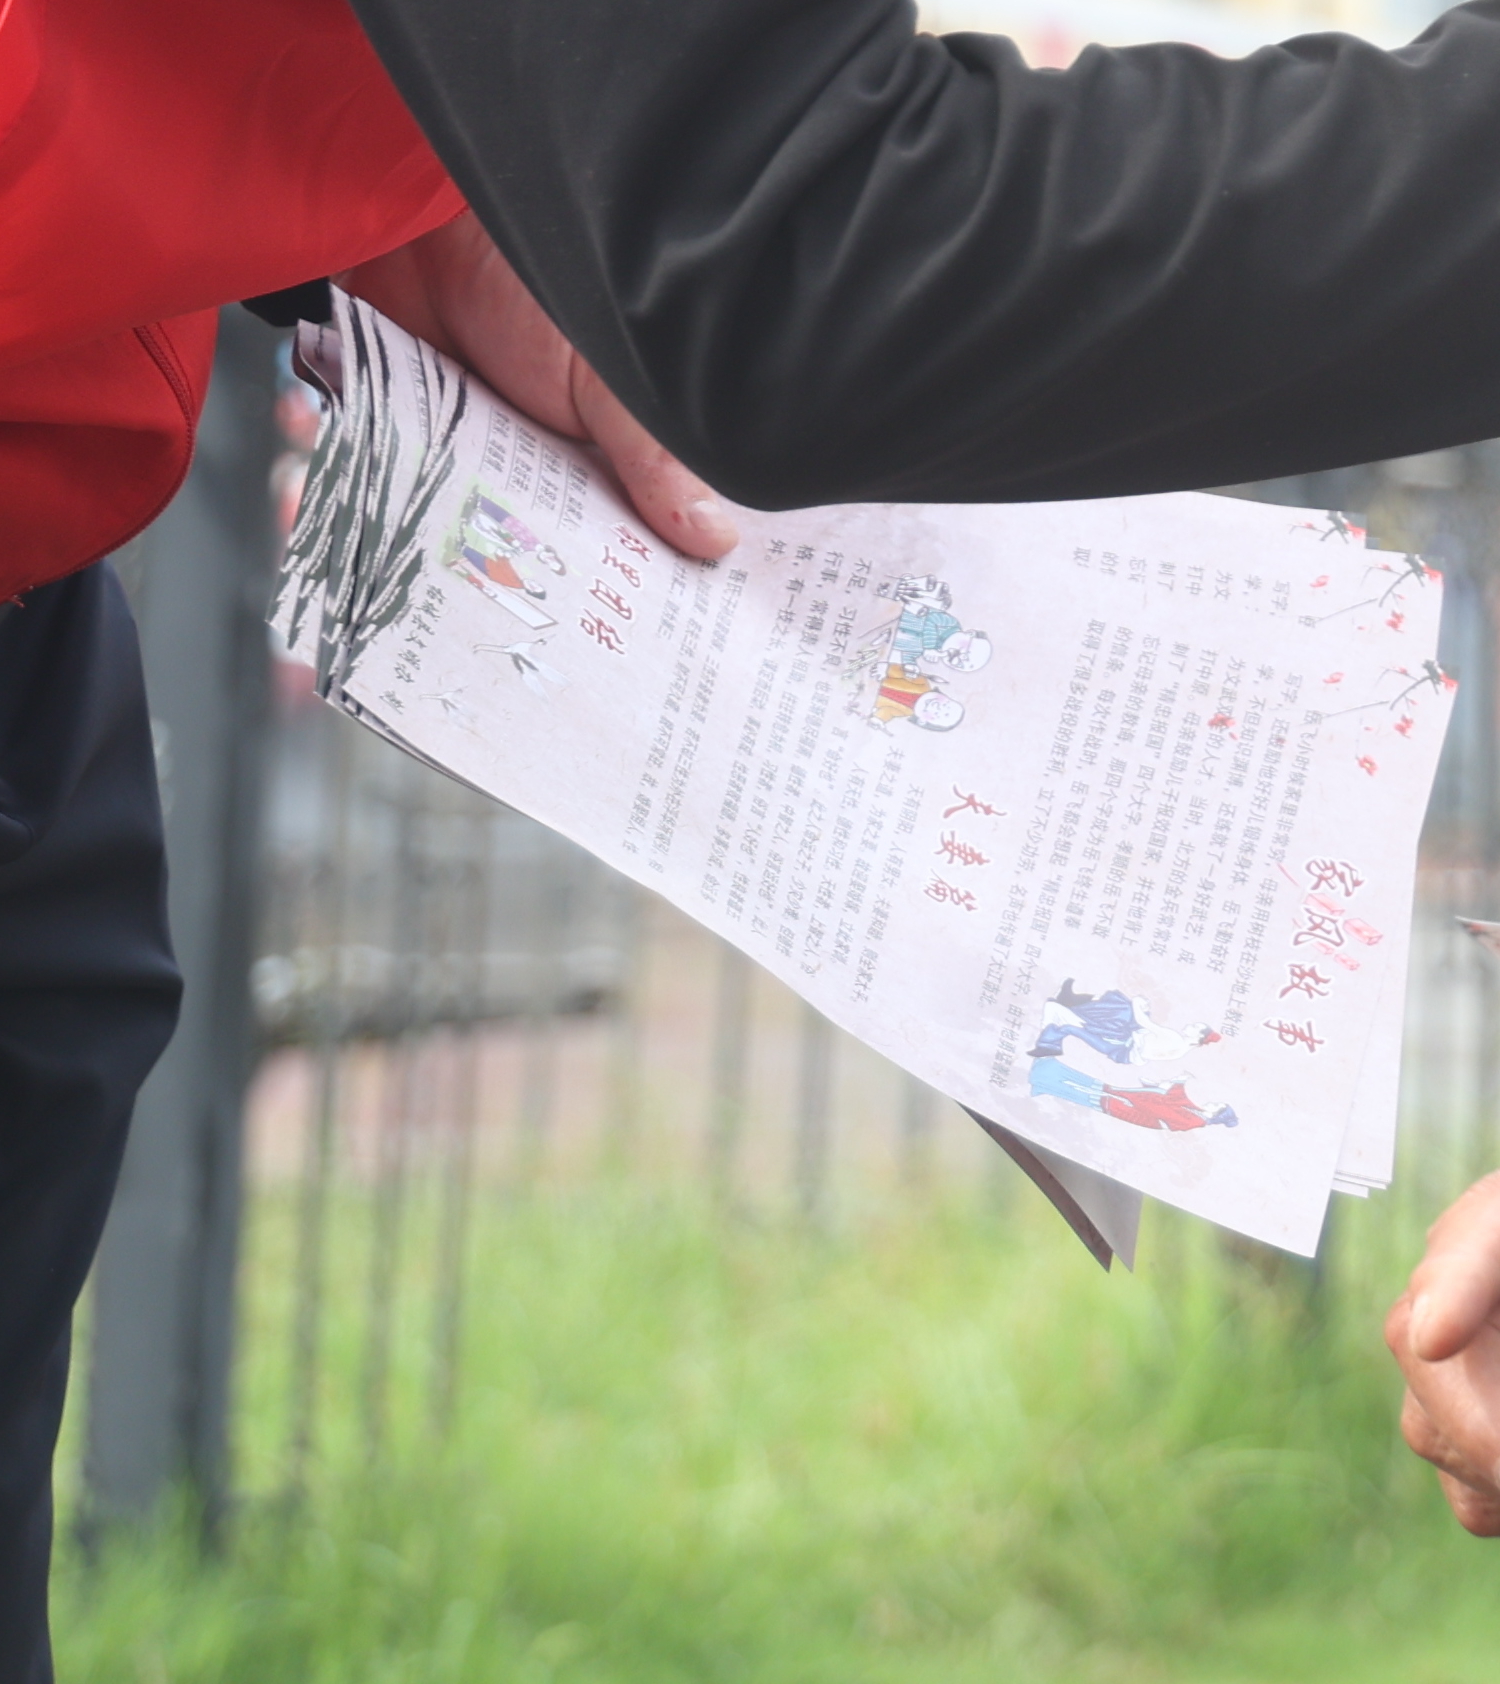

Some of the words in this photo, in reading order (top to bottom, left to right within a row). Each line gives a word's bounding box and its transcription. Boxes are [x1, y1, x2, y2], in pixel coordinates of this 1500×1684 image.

[577, 522, 656, 658] 邻里团结
[929, 783, 1008, 914] 夫妻篇
[1264, 853, 1364, 1054] 家风故事
